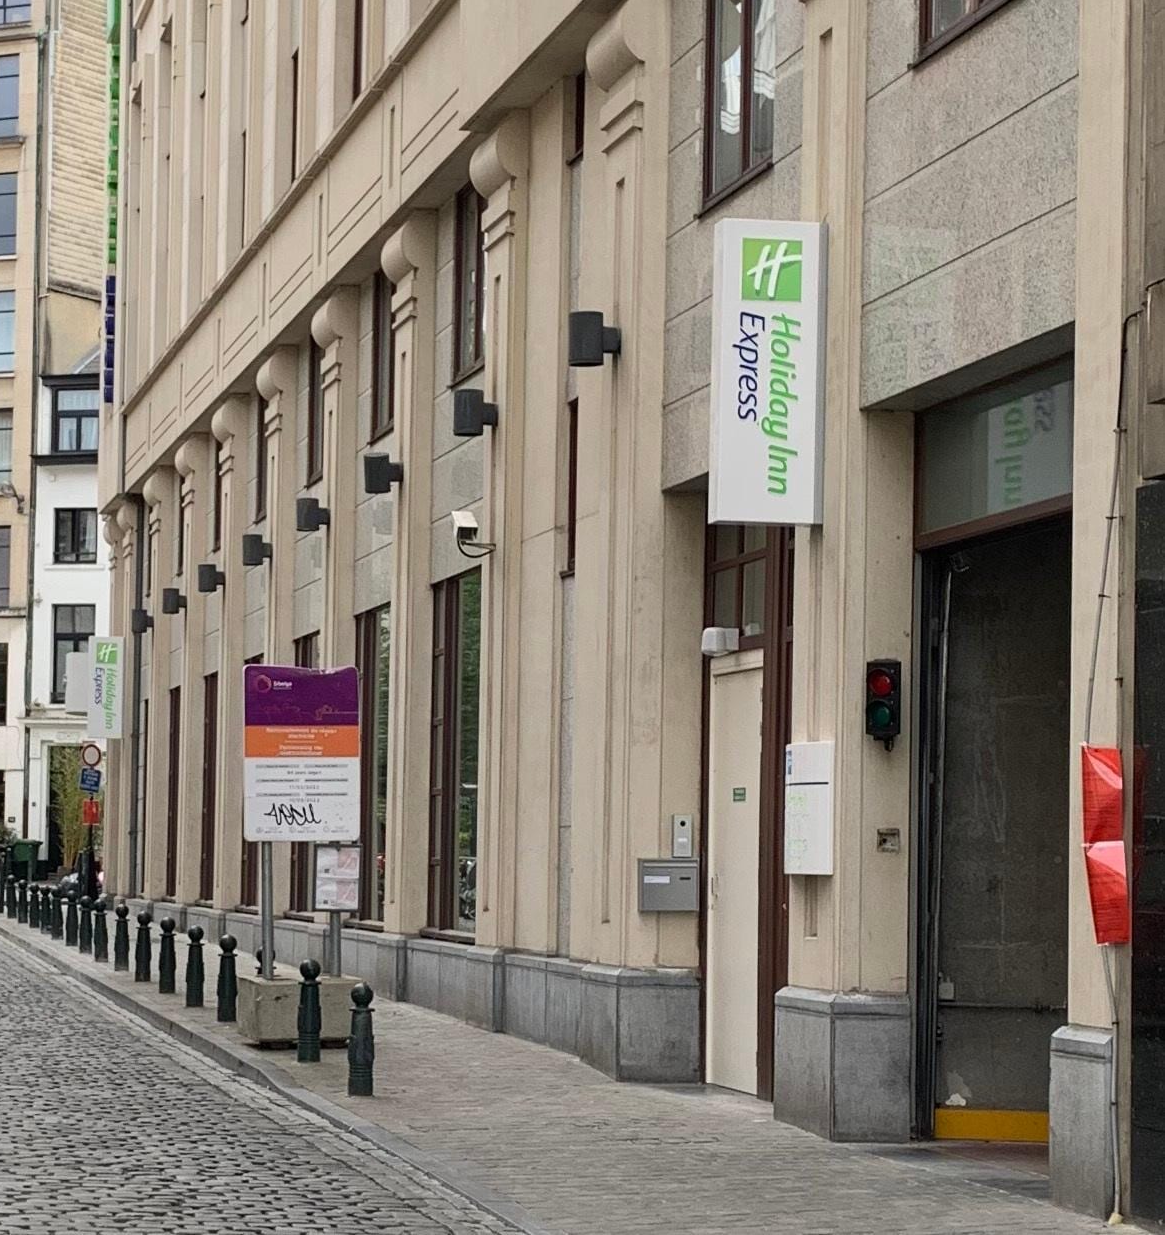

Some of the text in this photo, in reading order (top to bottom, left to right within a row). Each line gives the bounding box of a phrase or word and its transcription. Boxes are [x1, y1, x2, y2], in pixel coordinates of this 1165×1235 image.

[732, 311, 766, 422] Express
[761, 313, 802, 496] Holiday Inn
[92, 667, 106, 705] Express
[102, 668, 118, 730] Holiday Inn
